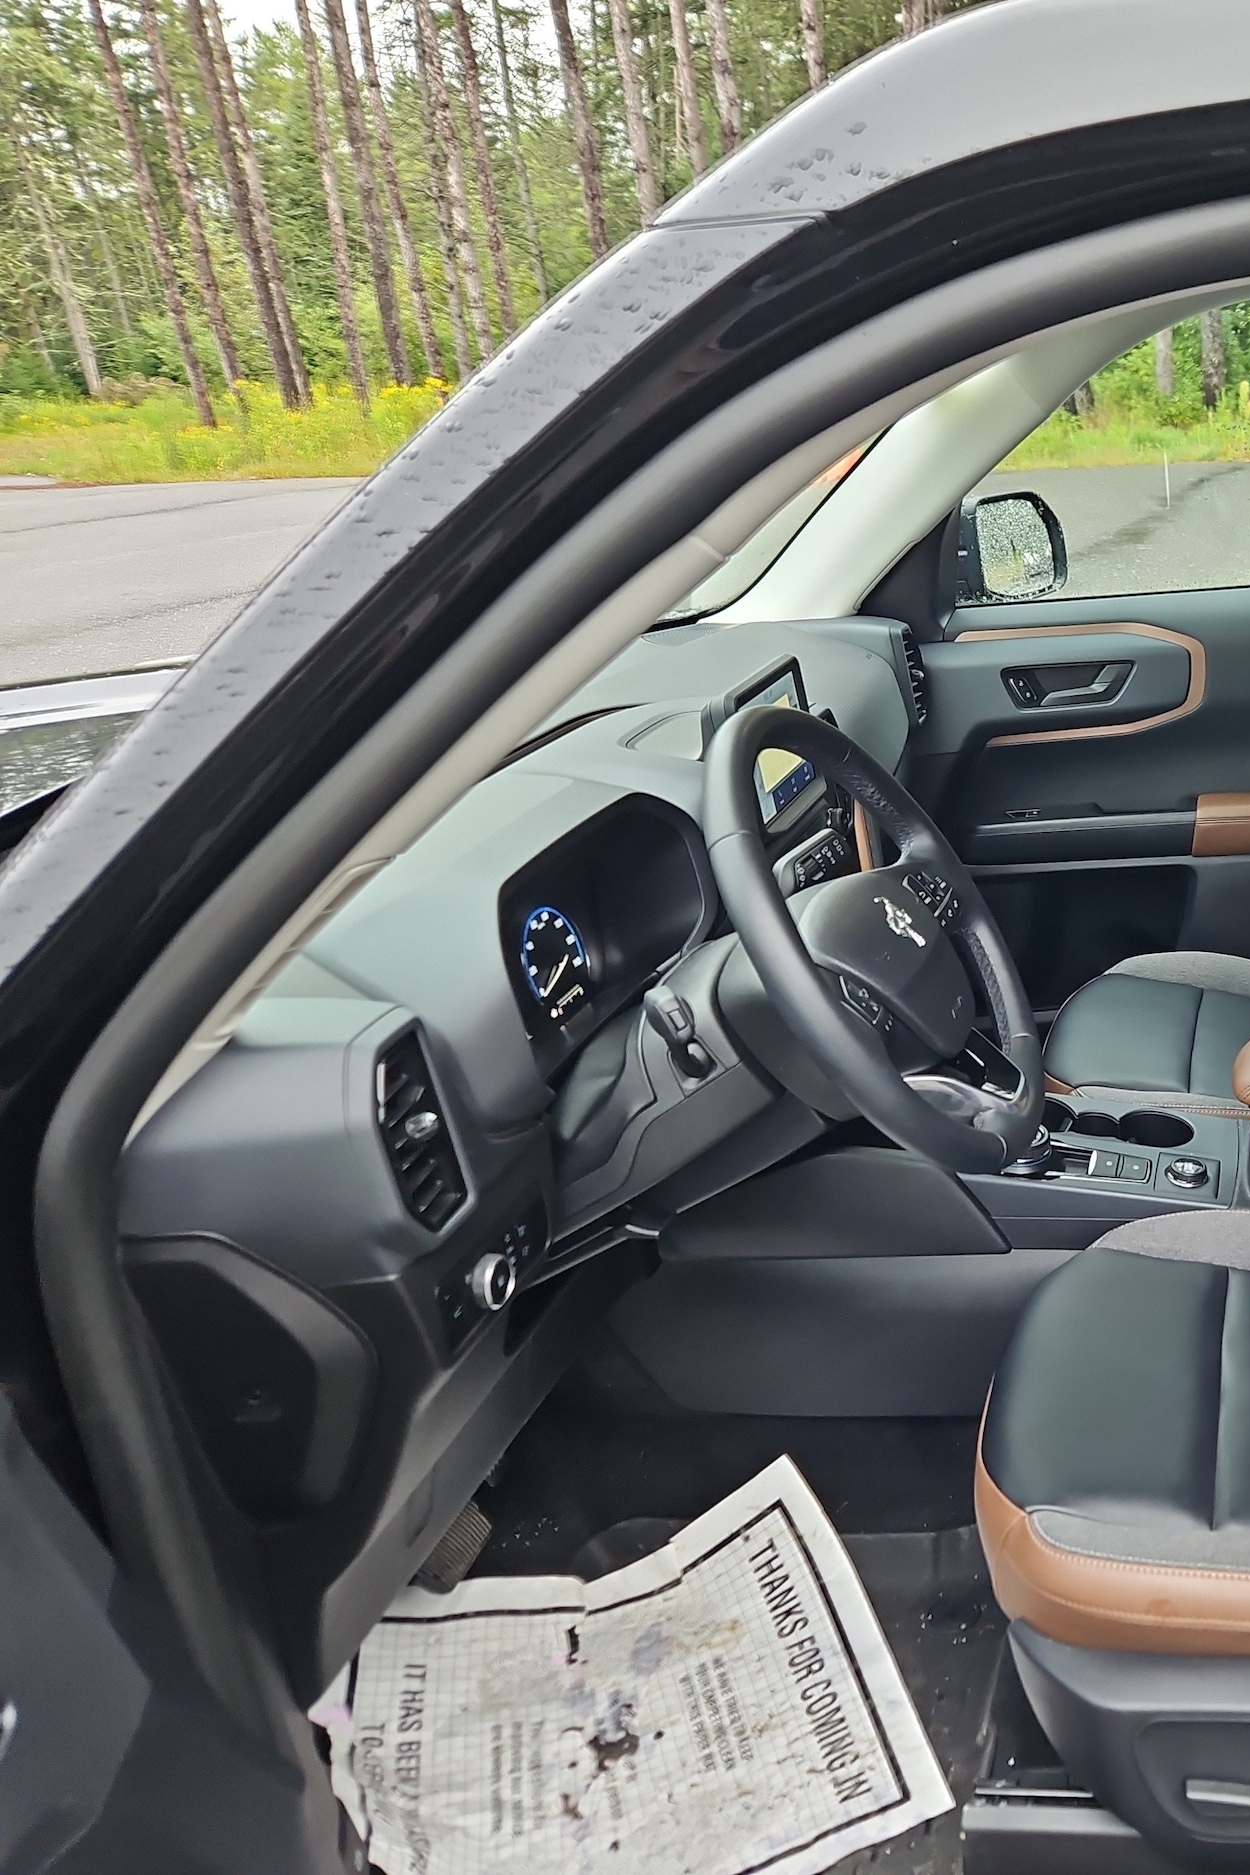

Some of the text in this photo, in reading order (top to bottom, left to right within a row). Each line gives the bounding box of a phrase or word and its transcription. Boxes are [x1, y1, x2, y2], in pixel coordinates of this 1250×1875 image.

[403, 1664, 427, 1682] IT
[748, 1538, 873, 1804] THANKS FOR COMING IN
[397, 1690, 425, 1734] HAS
[360, 1722, 385, 1748] TO
[718, 1739, 736, 1772] CLEAN
